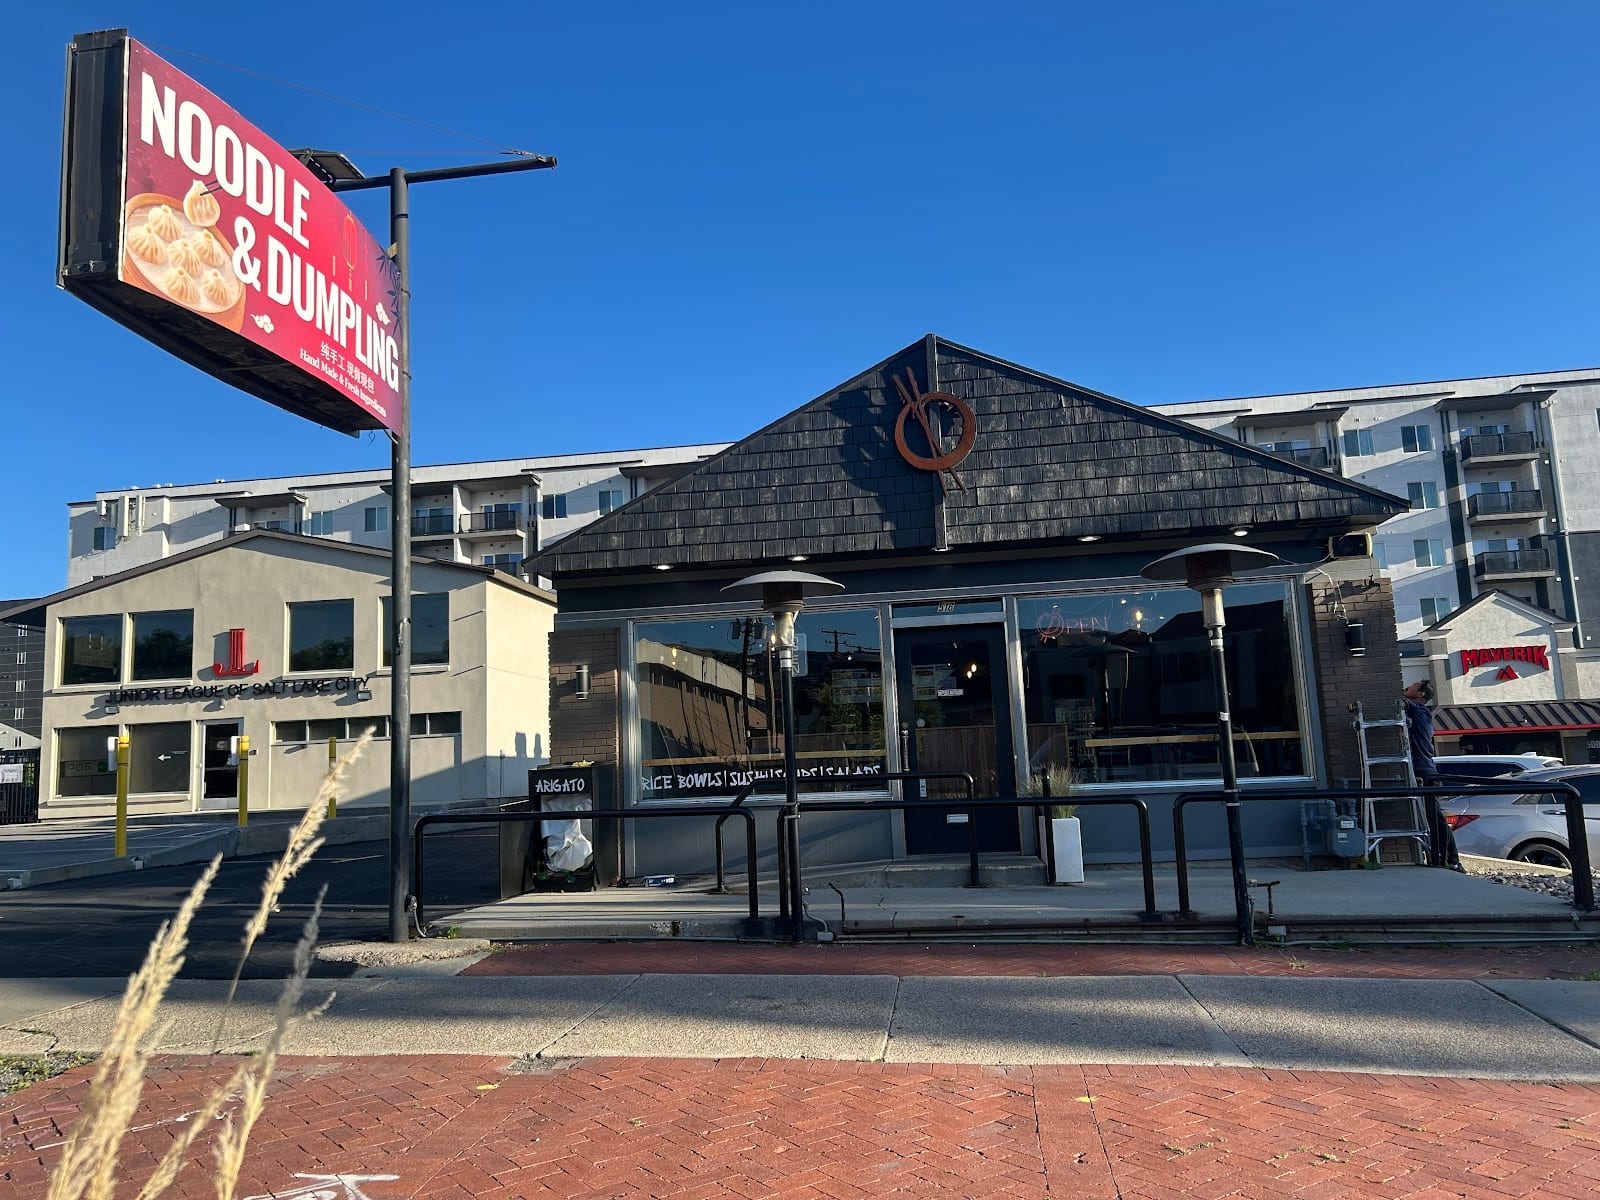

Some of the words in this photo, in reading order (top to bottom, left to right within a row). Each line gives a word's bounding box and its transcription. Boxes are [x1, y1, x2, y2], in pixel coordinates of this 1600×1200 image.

[140, 71, 310, 249] NOODLE
[232, 215, 261, 292] &
[267, 235, 399, 393] DUMPLING
[300, 347, 320, 369] Hand
[321, 361, 338, 382] Made
[339, 374, 345, 386] &
[345, 377, 360, 397] Fresh
[1036, 611, 1109, 639] OPEN
[1461, 645, 1549, 676] MAVERIK
[105, 688, 160, 703] JUNIOR
[164, 685, 224, 700] LEAGUE
[227, 683, 248, 696] OF
[253, 681, 290, 695] SALT
[292, 679, 330, 693] LAKE
[335, 677, 370, 691] CITY
[535, 778, 585, 793] ARIGATO
[641, 775, 673, 790] RICE
[678, 771, 722, 788] BOWLS
